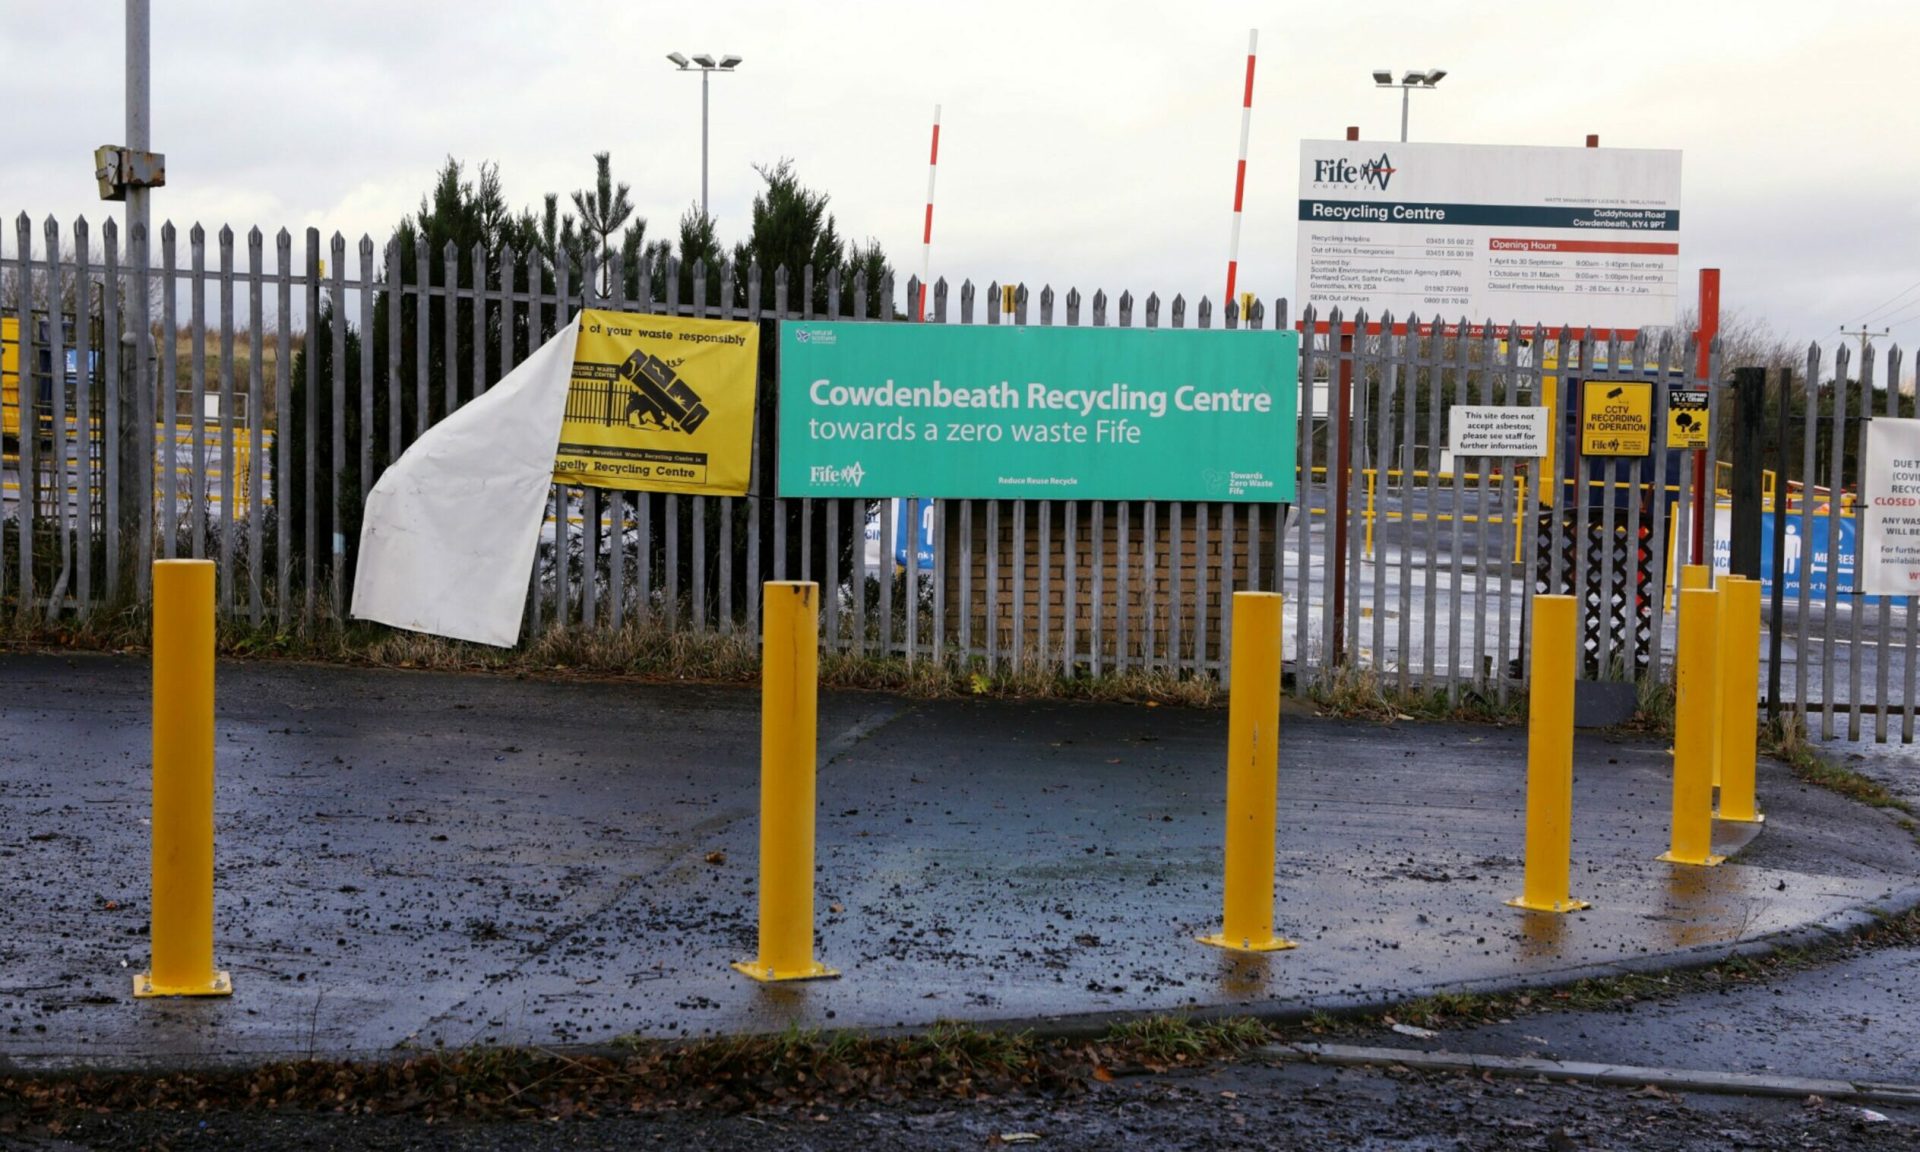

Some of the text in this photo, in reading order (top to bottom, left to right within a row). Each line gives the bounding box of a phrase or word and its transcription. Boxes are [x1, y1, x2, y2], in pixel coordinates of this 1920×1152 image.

[1314, 158, 1357, 183] Fife
[1312, 203, 1445, 221] Recycling Centre
[1594, 209, 1666, 219] Cuddyhouse Road
[1573, 219, 1630, 229] Cowdenbeath,
[1650, 221, 1666, 229] 9PT
[1492, 240, 1557, 251] Opening Hours
[590, 325, 601, 334] of
[607, 326, 632, 337] your
[638, 329, 673, 340] waste
[679, 332, 746, 347] responsibly
[809, 379, 1272, 418] Cowdenbeath Recycling Centre
[1605, 405, 1630, 414] CCTV
[1484, 412, 1498, 420] site
[1591, 414, 1642, 423] RECORDING
[809, 416, 1142, 444] towards a zero waste Fife
[1467, 423, 1532, 431] accept asbestos;
[1586, 423, 1647, 432] IN OPERATION
[1463, 432, 1488, 440] please
[1490, 442, 1538, 450] information
[1893, 460, 1913, 468] DUE
[594, 461, 650, 477] Recycling
[656, 466, 696, 478] Centre
[811, 465, 840, 482] Fife
[1229, 471, 1264, 480] Towards
[1892, 472, 1920, 481] (COVI
[1050, 477, 1078, 487] Recycle
[1230, 480, 1274, 488] Zero Waste
[1229, 488, 1245, 496] Fife
[1874, 497, 1916, 507] CLOSED
[1882, 517, 1900, 525] ANY
[1886, 528, 1908, 536] WILL
[1881, 546, 1894, 554] For
